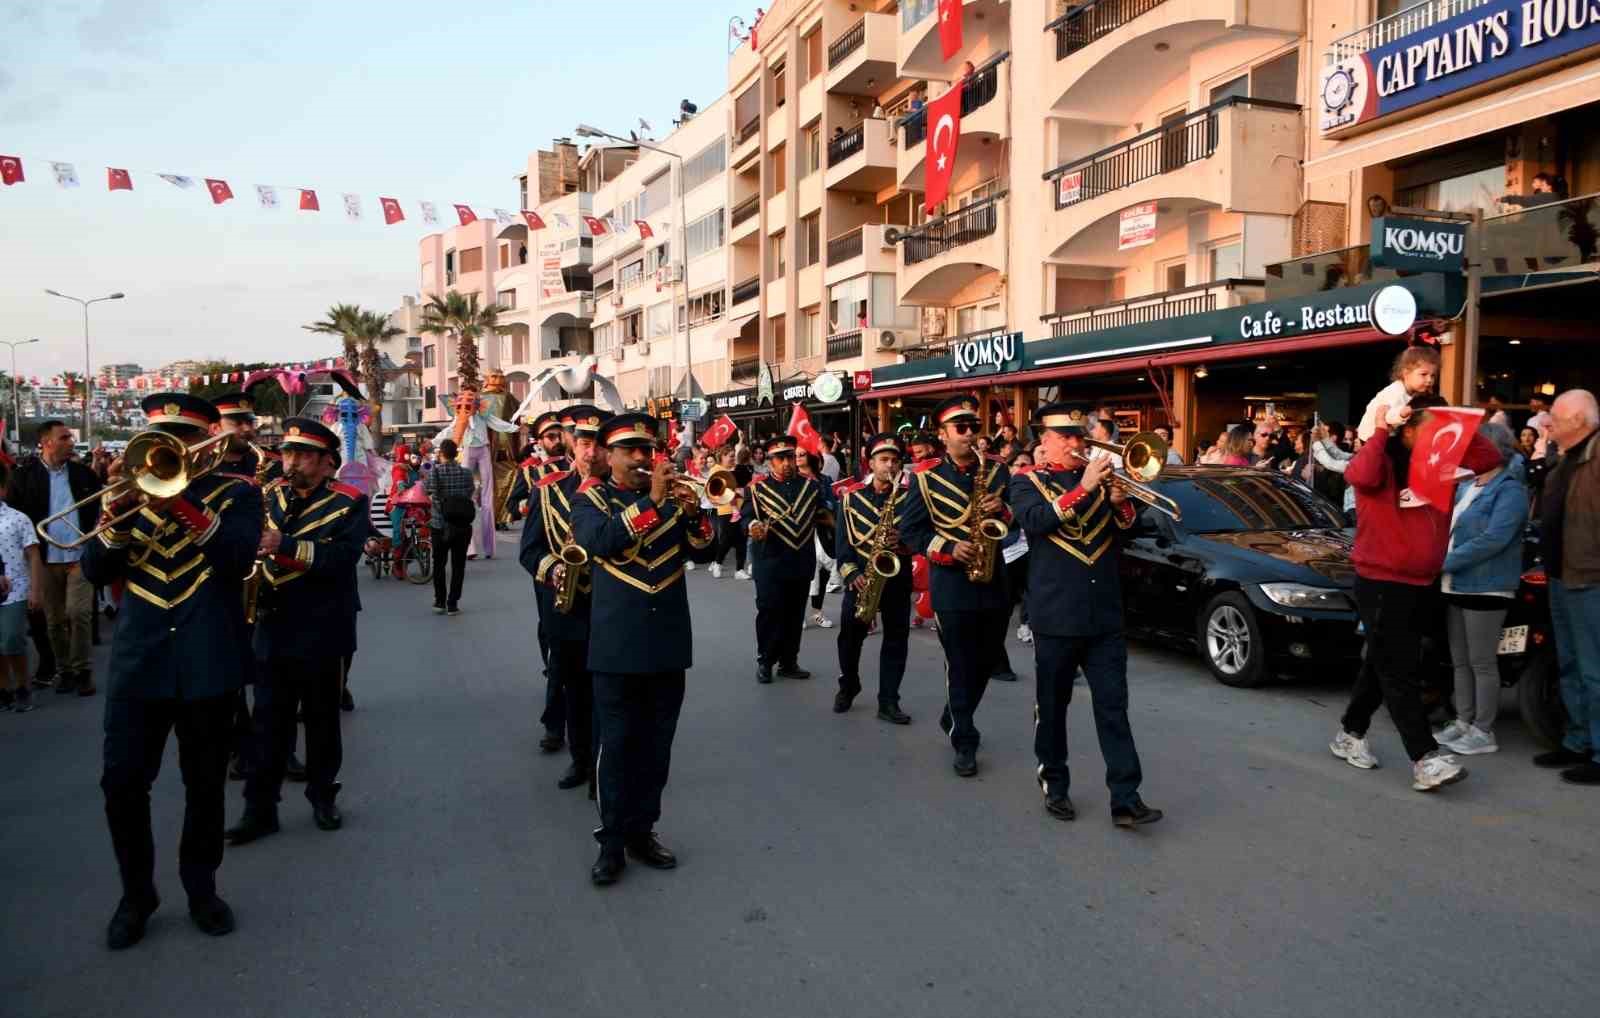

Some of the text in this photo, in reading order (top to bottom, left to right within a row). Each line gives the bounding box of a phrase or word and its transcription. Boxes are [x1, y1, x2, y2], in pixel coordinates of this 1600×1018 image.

[1376, 10, 1509, 97] CAPTAIN'S
[1384, 227, 1464, 260] KOMŞU
[1240, 310, 1281, 338] Cafe
[954, 333, 1015, 372] KOMŞU
